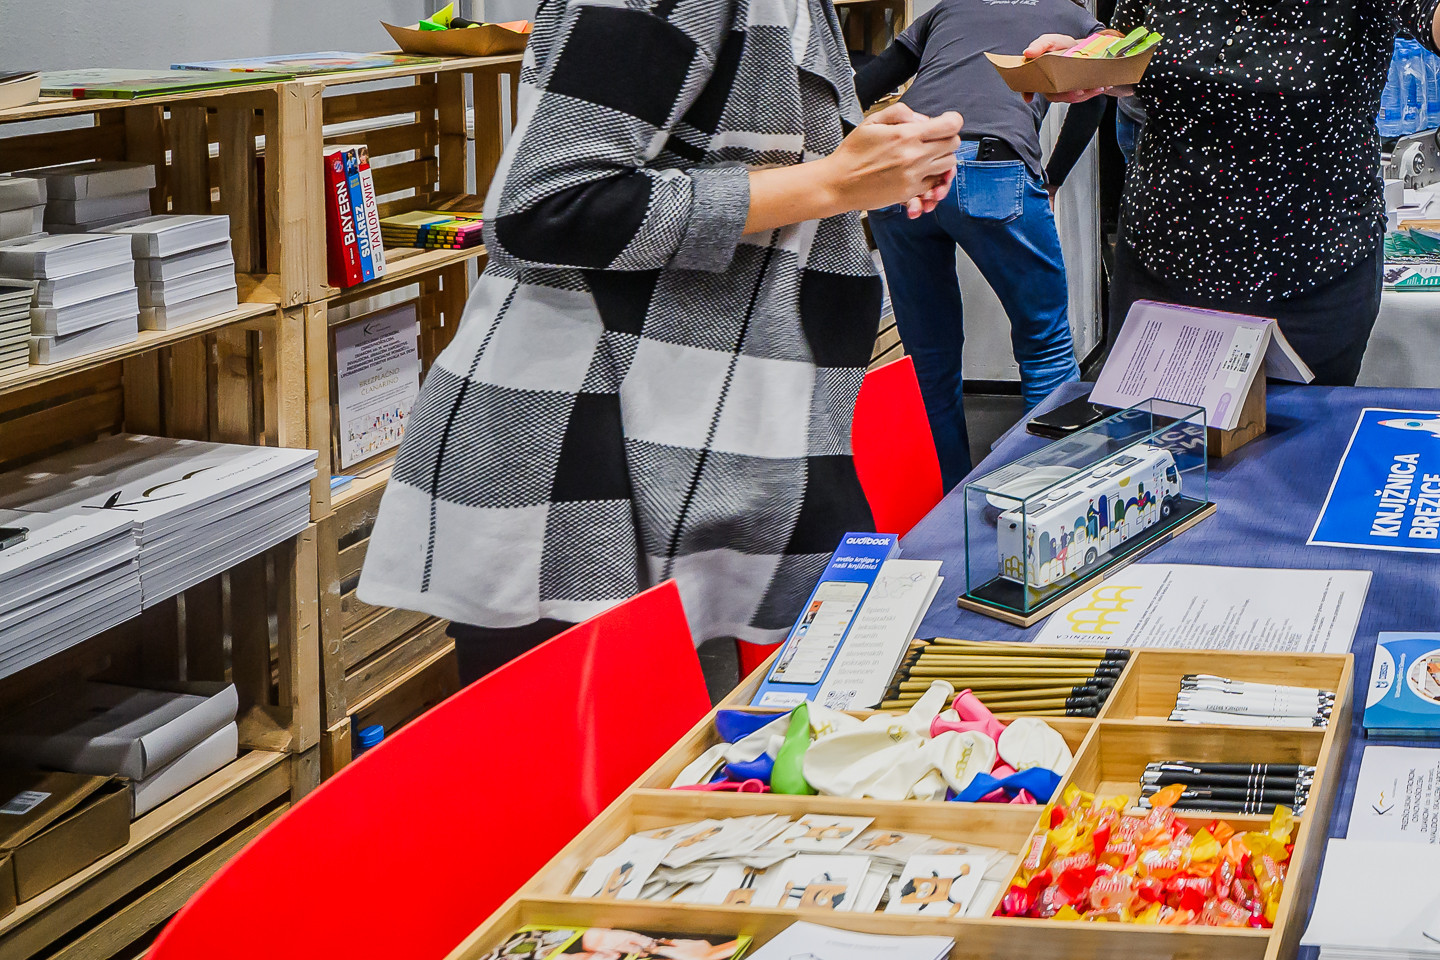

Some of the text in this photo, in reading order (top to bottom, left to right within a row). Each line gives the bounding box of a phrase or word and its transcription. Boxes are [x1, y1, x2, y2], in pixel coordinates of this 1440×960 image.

[336, 180, 356, 247] BAYERN
[362, 175, 376, 208] SWIFT
[355, 203, 371, 259] SUÁREZ
[367, 209, 381, 251] TAYLOR
[359, 367, 400, 388] BREZPLAČNO
[1369, 453, 1420, 538] KNJIŽNICA
